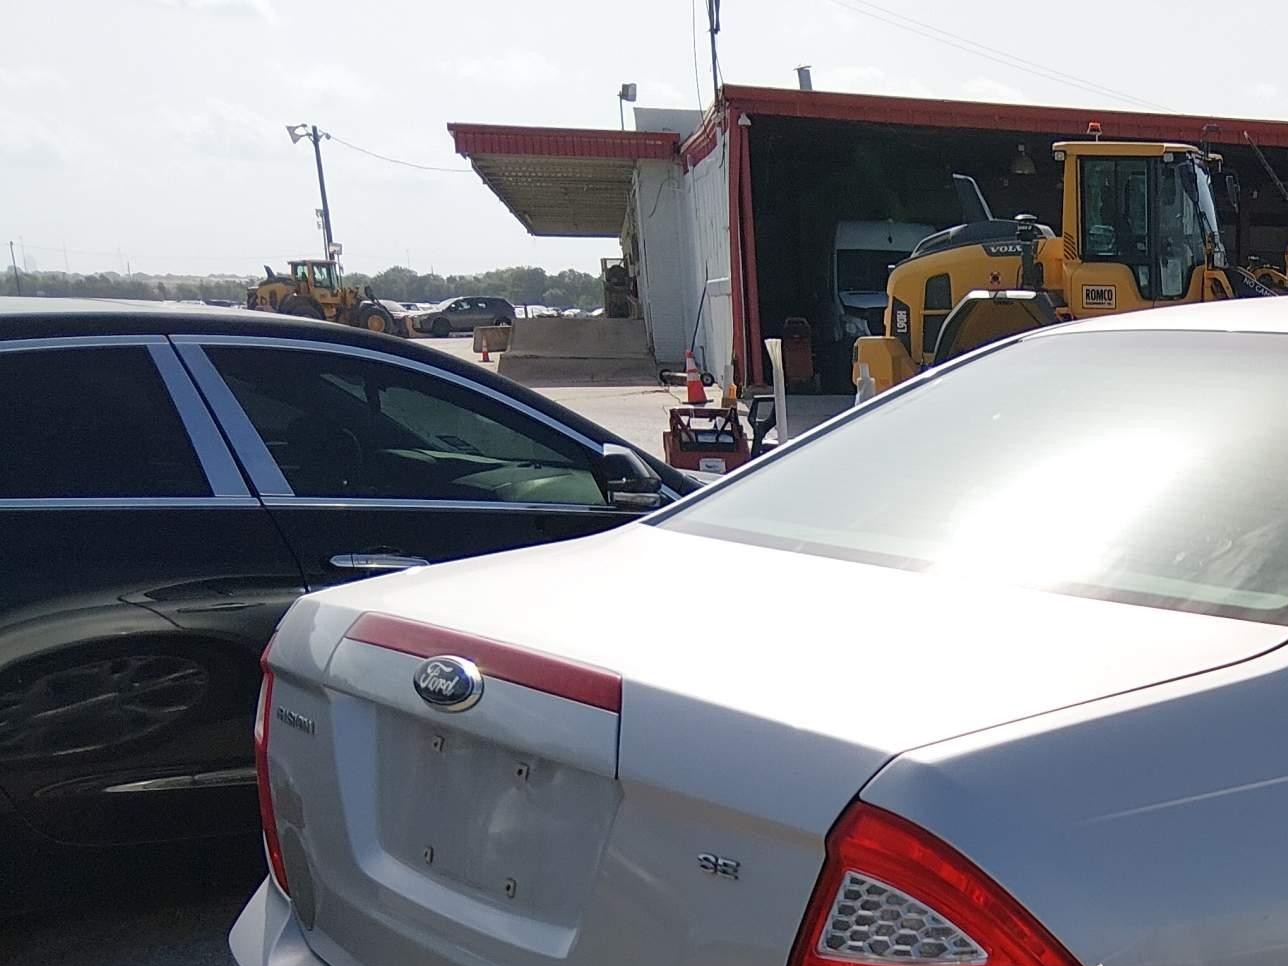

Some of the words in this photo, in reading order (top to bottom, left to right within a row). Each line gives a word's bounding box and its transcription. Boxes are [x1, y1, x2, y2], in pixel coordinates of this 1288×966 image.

[991, 244, 1023, 253] VOLV
[1085, 288, 1113, 302] ROMCO
[420, 662, 460, 696] Ford
[697, 852, 740, 880] SE
